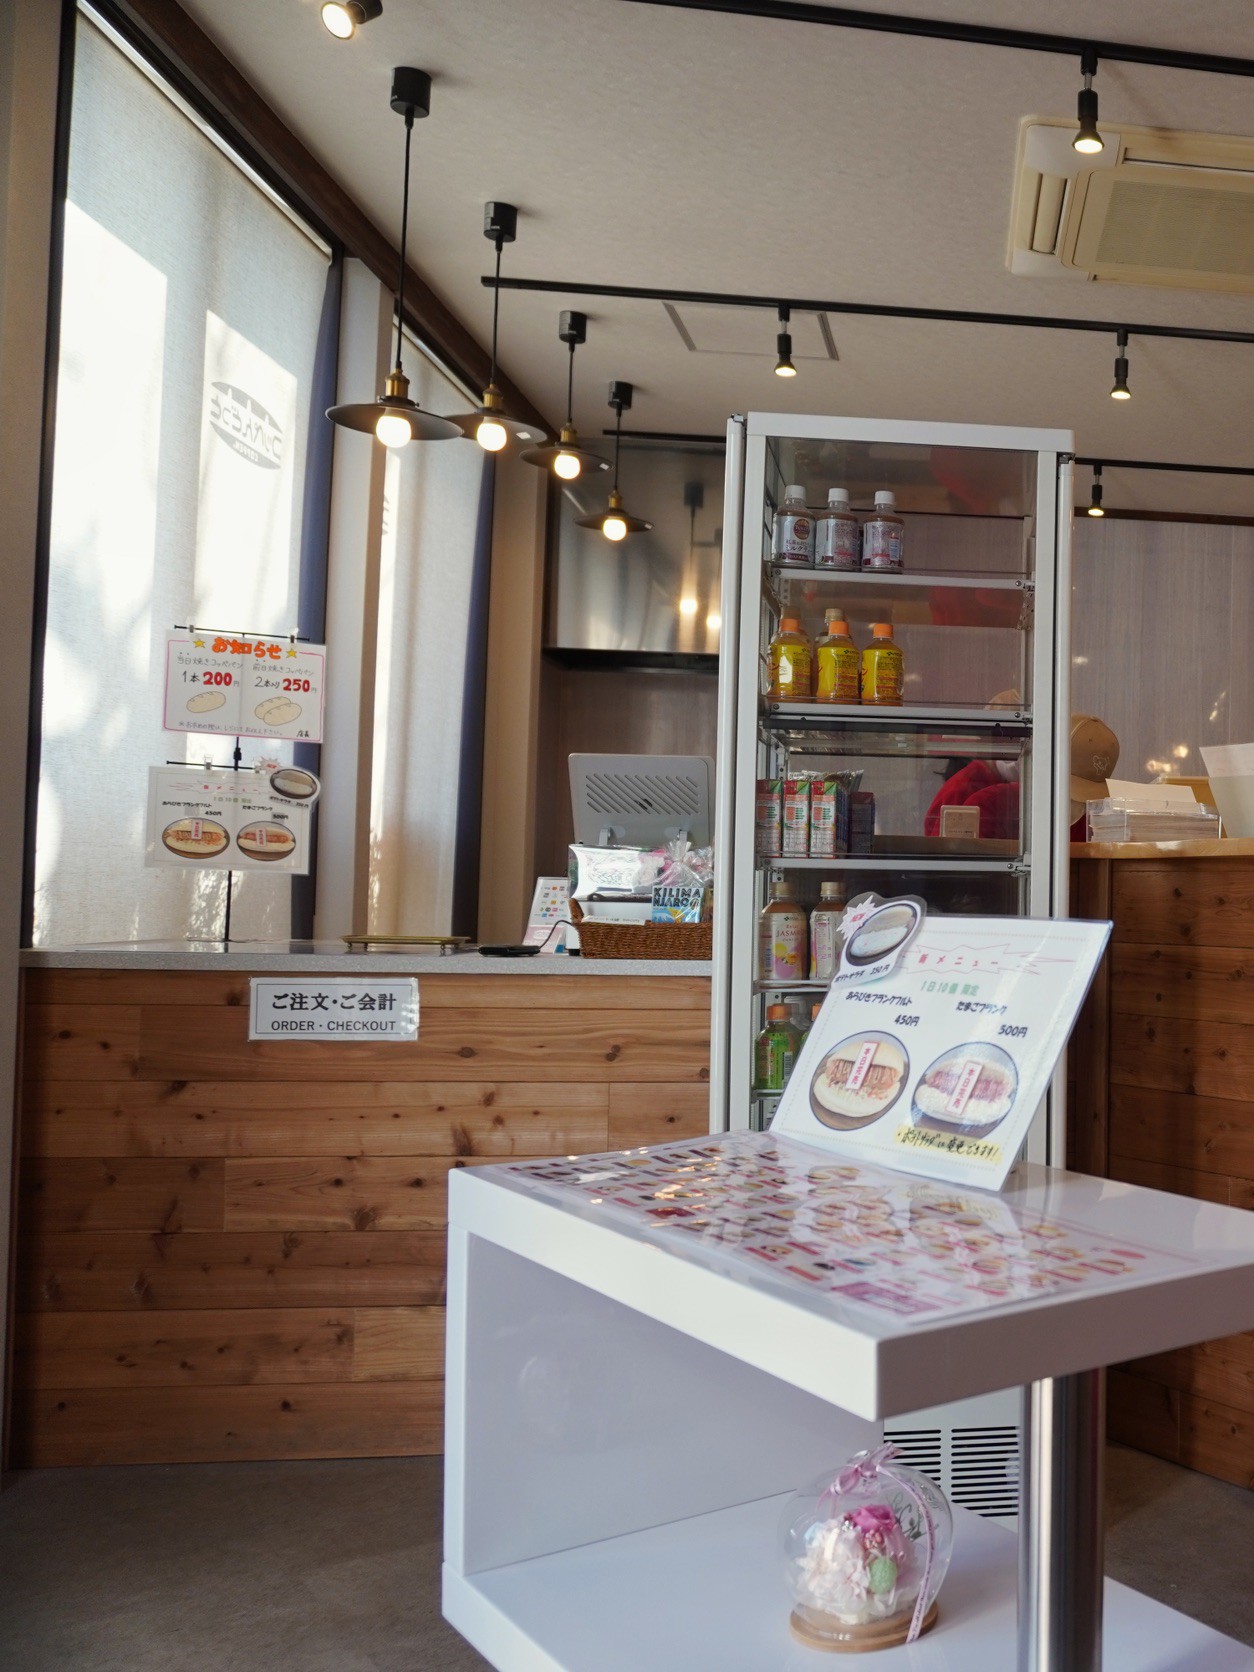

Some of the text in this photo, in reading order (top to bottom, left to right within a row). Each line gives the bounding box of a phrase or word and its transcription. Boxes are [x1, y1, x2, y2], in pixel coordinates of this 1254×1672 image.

[212, 637, 282, 660] お知らせ
[653, 887, 701, 898] KILIMA
[918, 953, 998, 967] 新メニュー
[272, 992, 397, 1011] ご注文・ご会計
[845, 990, 912, 1007] あらびきフランクフルト
[955, 1000, 1008, 1015] たまごフランク
[271, 1020, 396, 1031] ORDER CHECKOUT
[894, 1014, 920, 1027] 450円
[997, 1024, 1028, 1038] 500円
